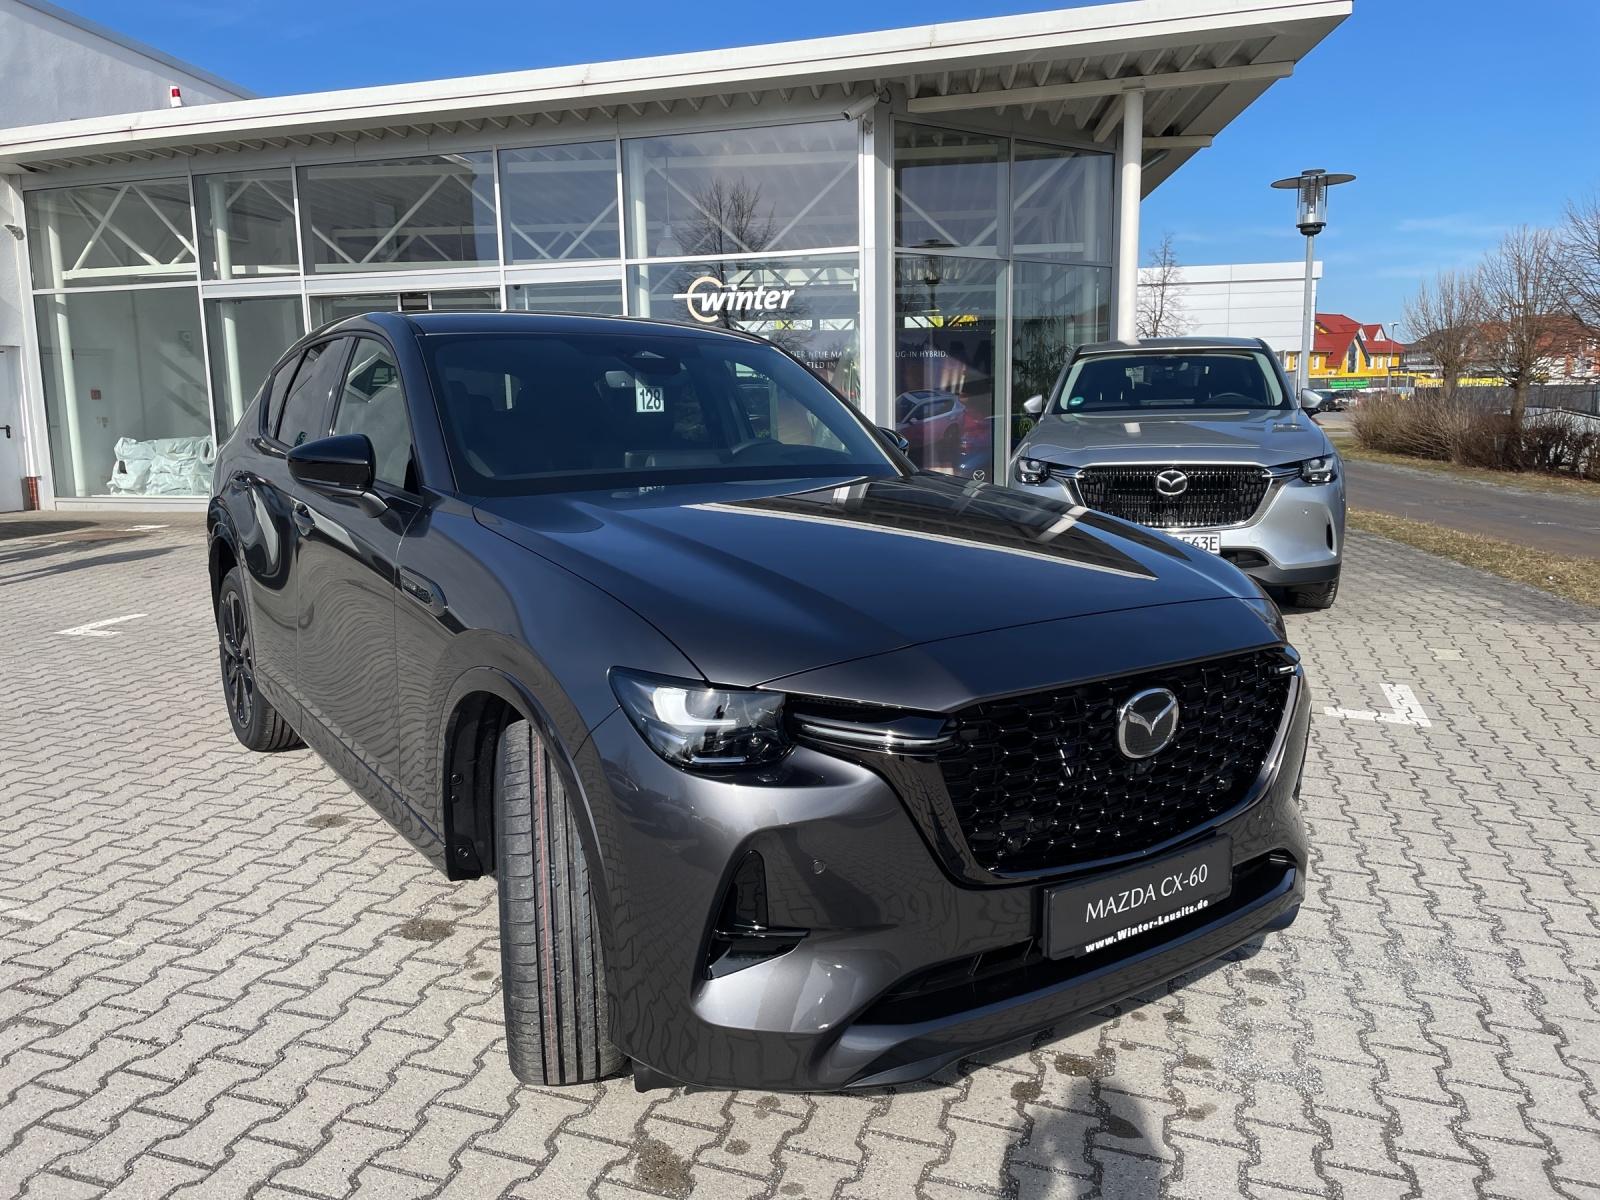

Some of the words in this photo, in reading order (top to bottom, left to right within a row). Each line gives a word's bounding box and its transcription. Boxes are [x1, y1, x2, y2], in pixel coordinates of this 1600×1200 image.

[700, 285, 796, 312] winter
[806, 361, 825, 369] FTED
[895, 350, 917, 358] UG-IN
[640, 388, 662, 410] 128
[1085, 883, 1157, 923] MAZDA
[1160, 863, 1208, 897] CX-60
[1085, 899, 1209, 953] www.Winter-Lausitz.de
